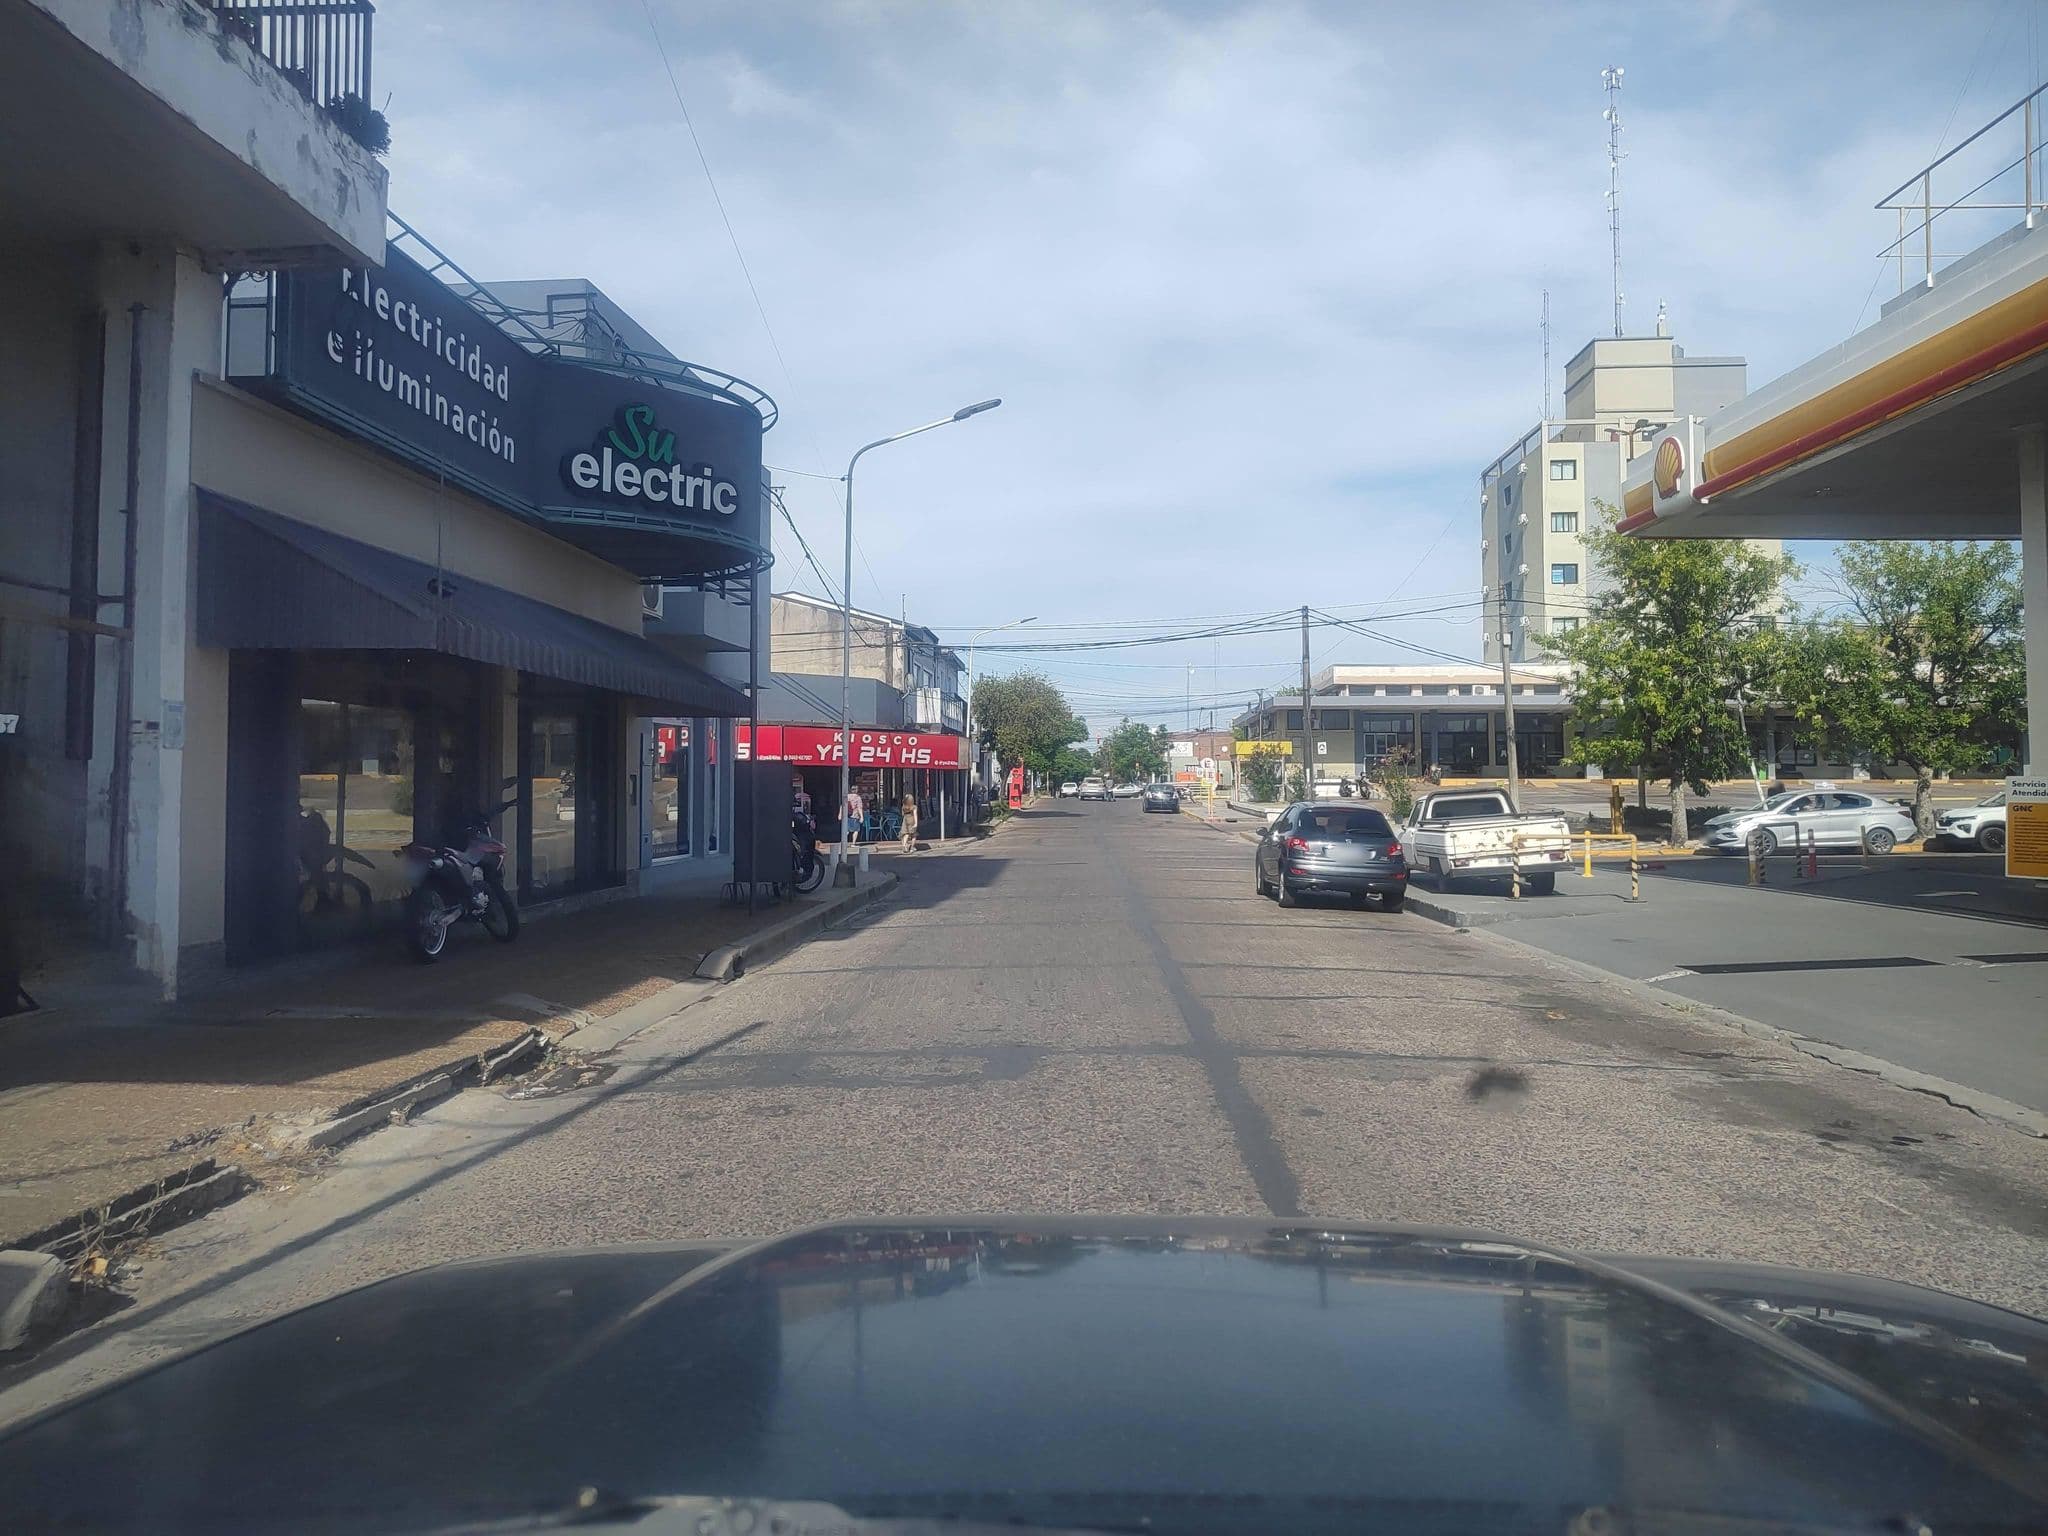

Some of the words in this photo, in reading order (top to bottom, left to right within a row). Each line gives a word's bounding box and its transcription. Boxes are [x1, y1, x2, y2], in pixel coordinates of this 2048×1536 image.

[327, 329, 343, 364] e
[355, 330, 515, 463] iluminación
[608, 405, 676, 465] Su
[571, 446, 737, 515] electric
[833, 732, 918, 746] KIOSCO
[859, 746, 891, 763] 24
[901, 747, 931, 764] HS
[2011, 780, 2046, 788] Servicio
[2013, 805, 2033, 813] GNC
